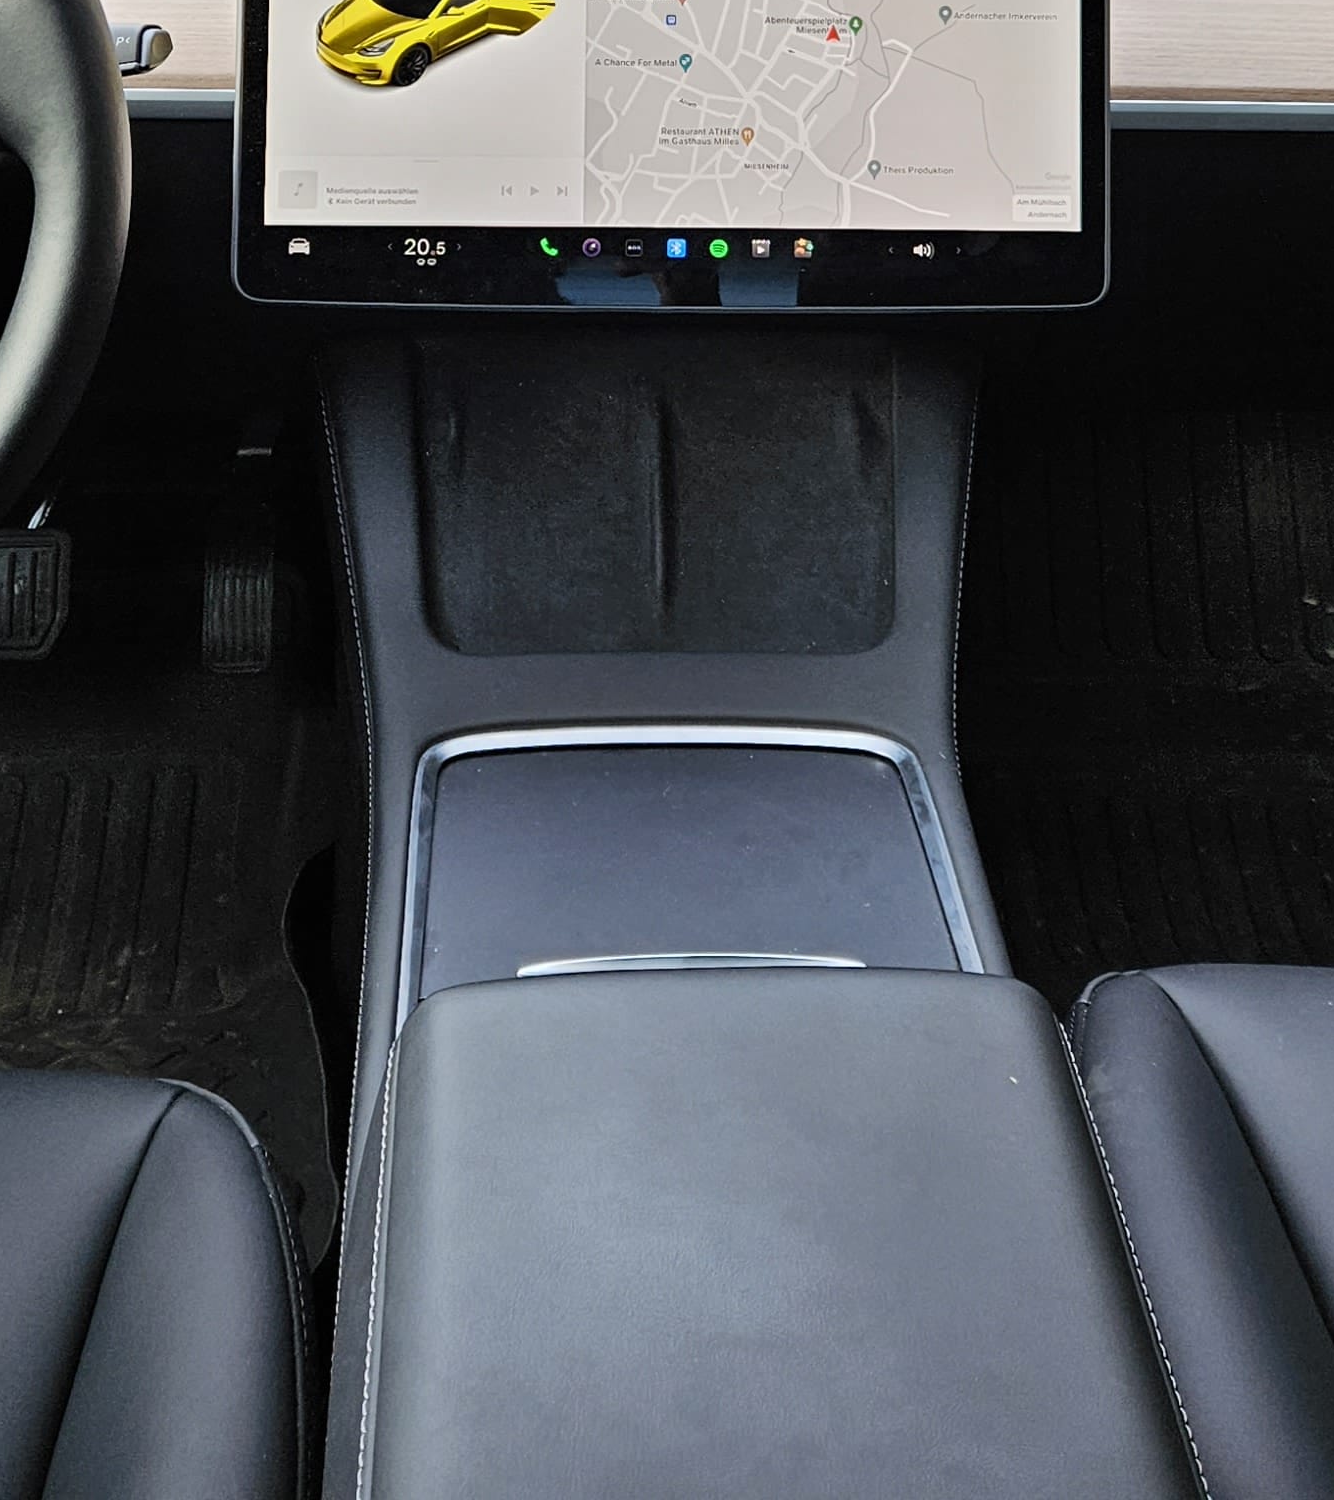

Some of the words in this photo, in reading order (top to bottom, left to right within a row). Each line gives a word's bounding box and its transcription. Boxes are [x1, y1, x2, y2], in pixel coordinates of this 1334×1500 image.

[954, 11, 1006, 20] Andernacher
[764, 16, 848, 26] Abenteuerspielplatz
[594, 58, 602, 66] A
[603, 58, 636, 67] Chance
[637, 58, 652, 67] For
[653, 59, 678, 67] Metal
[661, 127, 706, 136] Restaurant
[708, 127, 740, 136] ATHEN
[671, 136, 712, 145] Gasthaus
[907, 165, 954, 175] Produktion
[403, 238, 446, 256] 20.5
